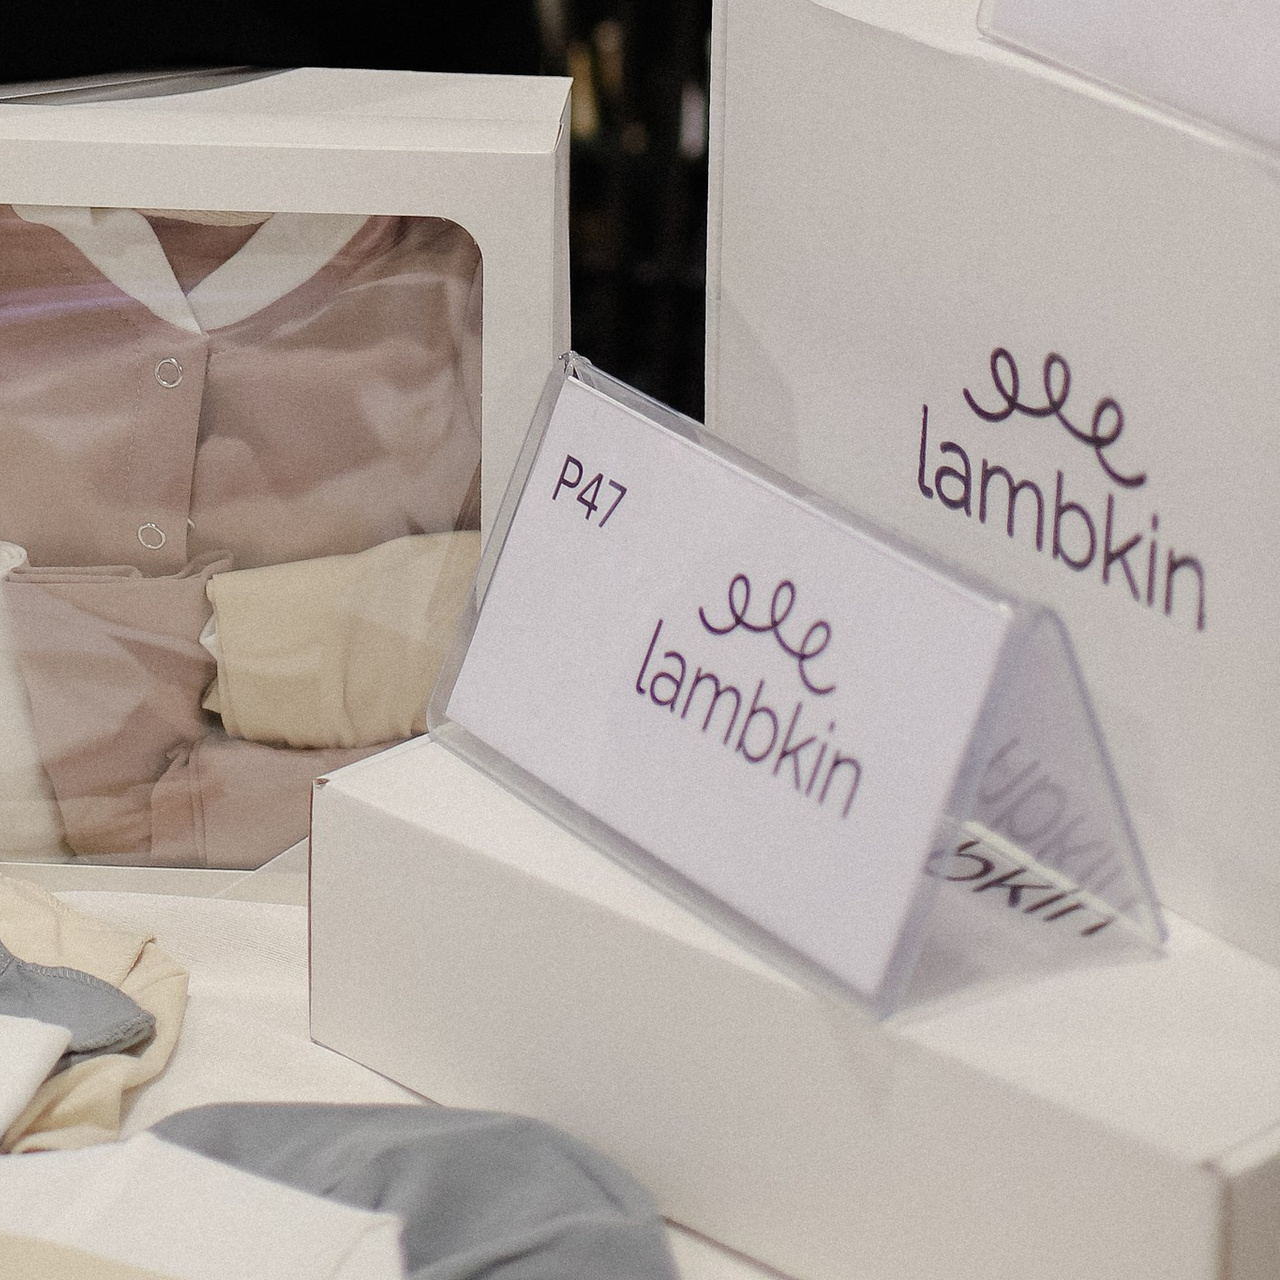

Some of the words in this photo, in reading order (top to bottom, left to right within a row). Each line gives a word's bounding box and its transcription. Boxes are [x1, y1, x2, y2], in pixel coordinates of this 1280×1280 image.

[551, 454, 628, 529] P47
[917, 403, 1207, 632] lambkin
[634, 618, 863, 818] lambkin
